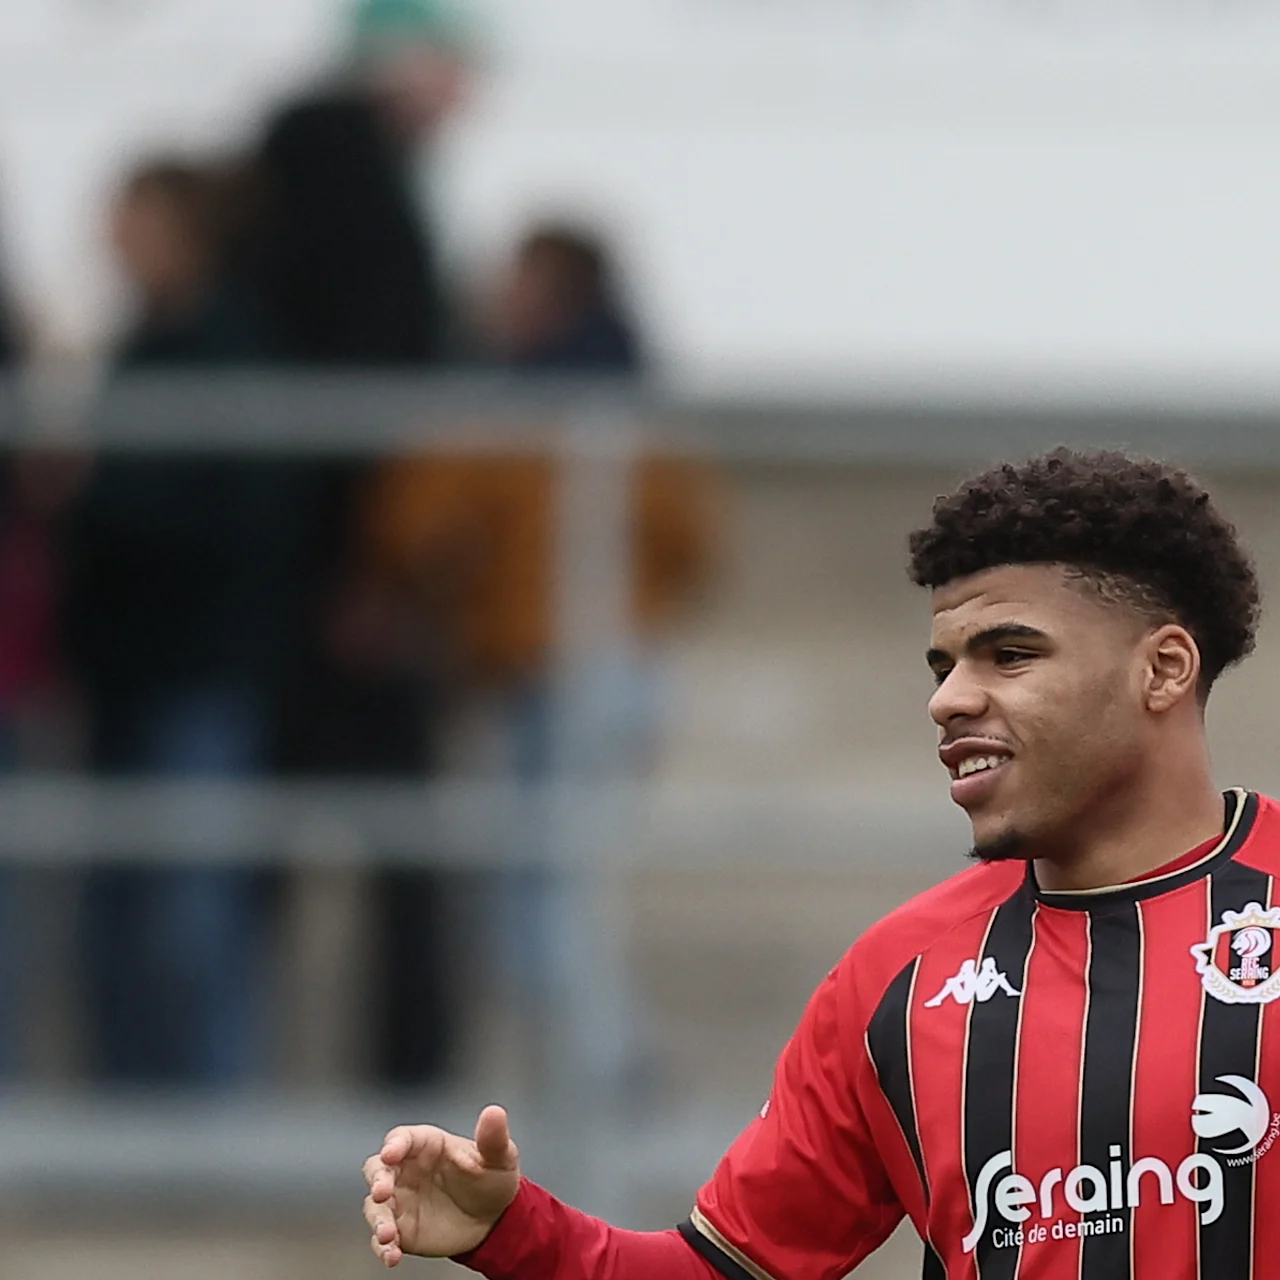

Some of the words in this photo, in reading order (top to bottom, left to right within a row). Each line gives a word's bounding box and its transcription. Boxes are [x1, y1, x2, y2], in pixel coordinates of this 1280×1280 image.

[961, 1144, 1225, 1254] Seraing
[992, 1222, 1025, 1248] Cité
[1028, 1224, 1047, 1244] de
[1051, 1214, 1124, 1239] demain
